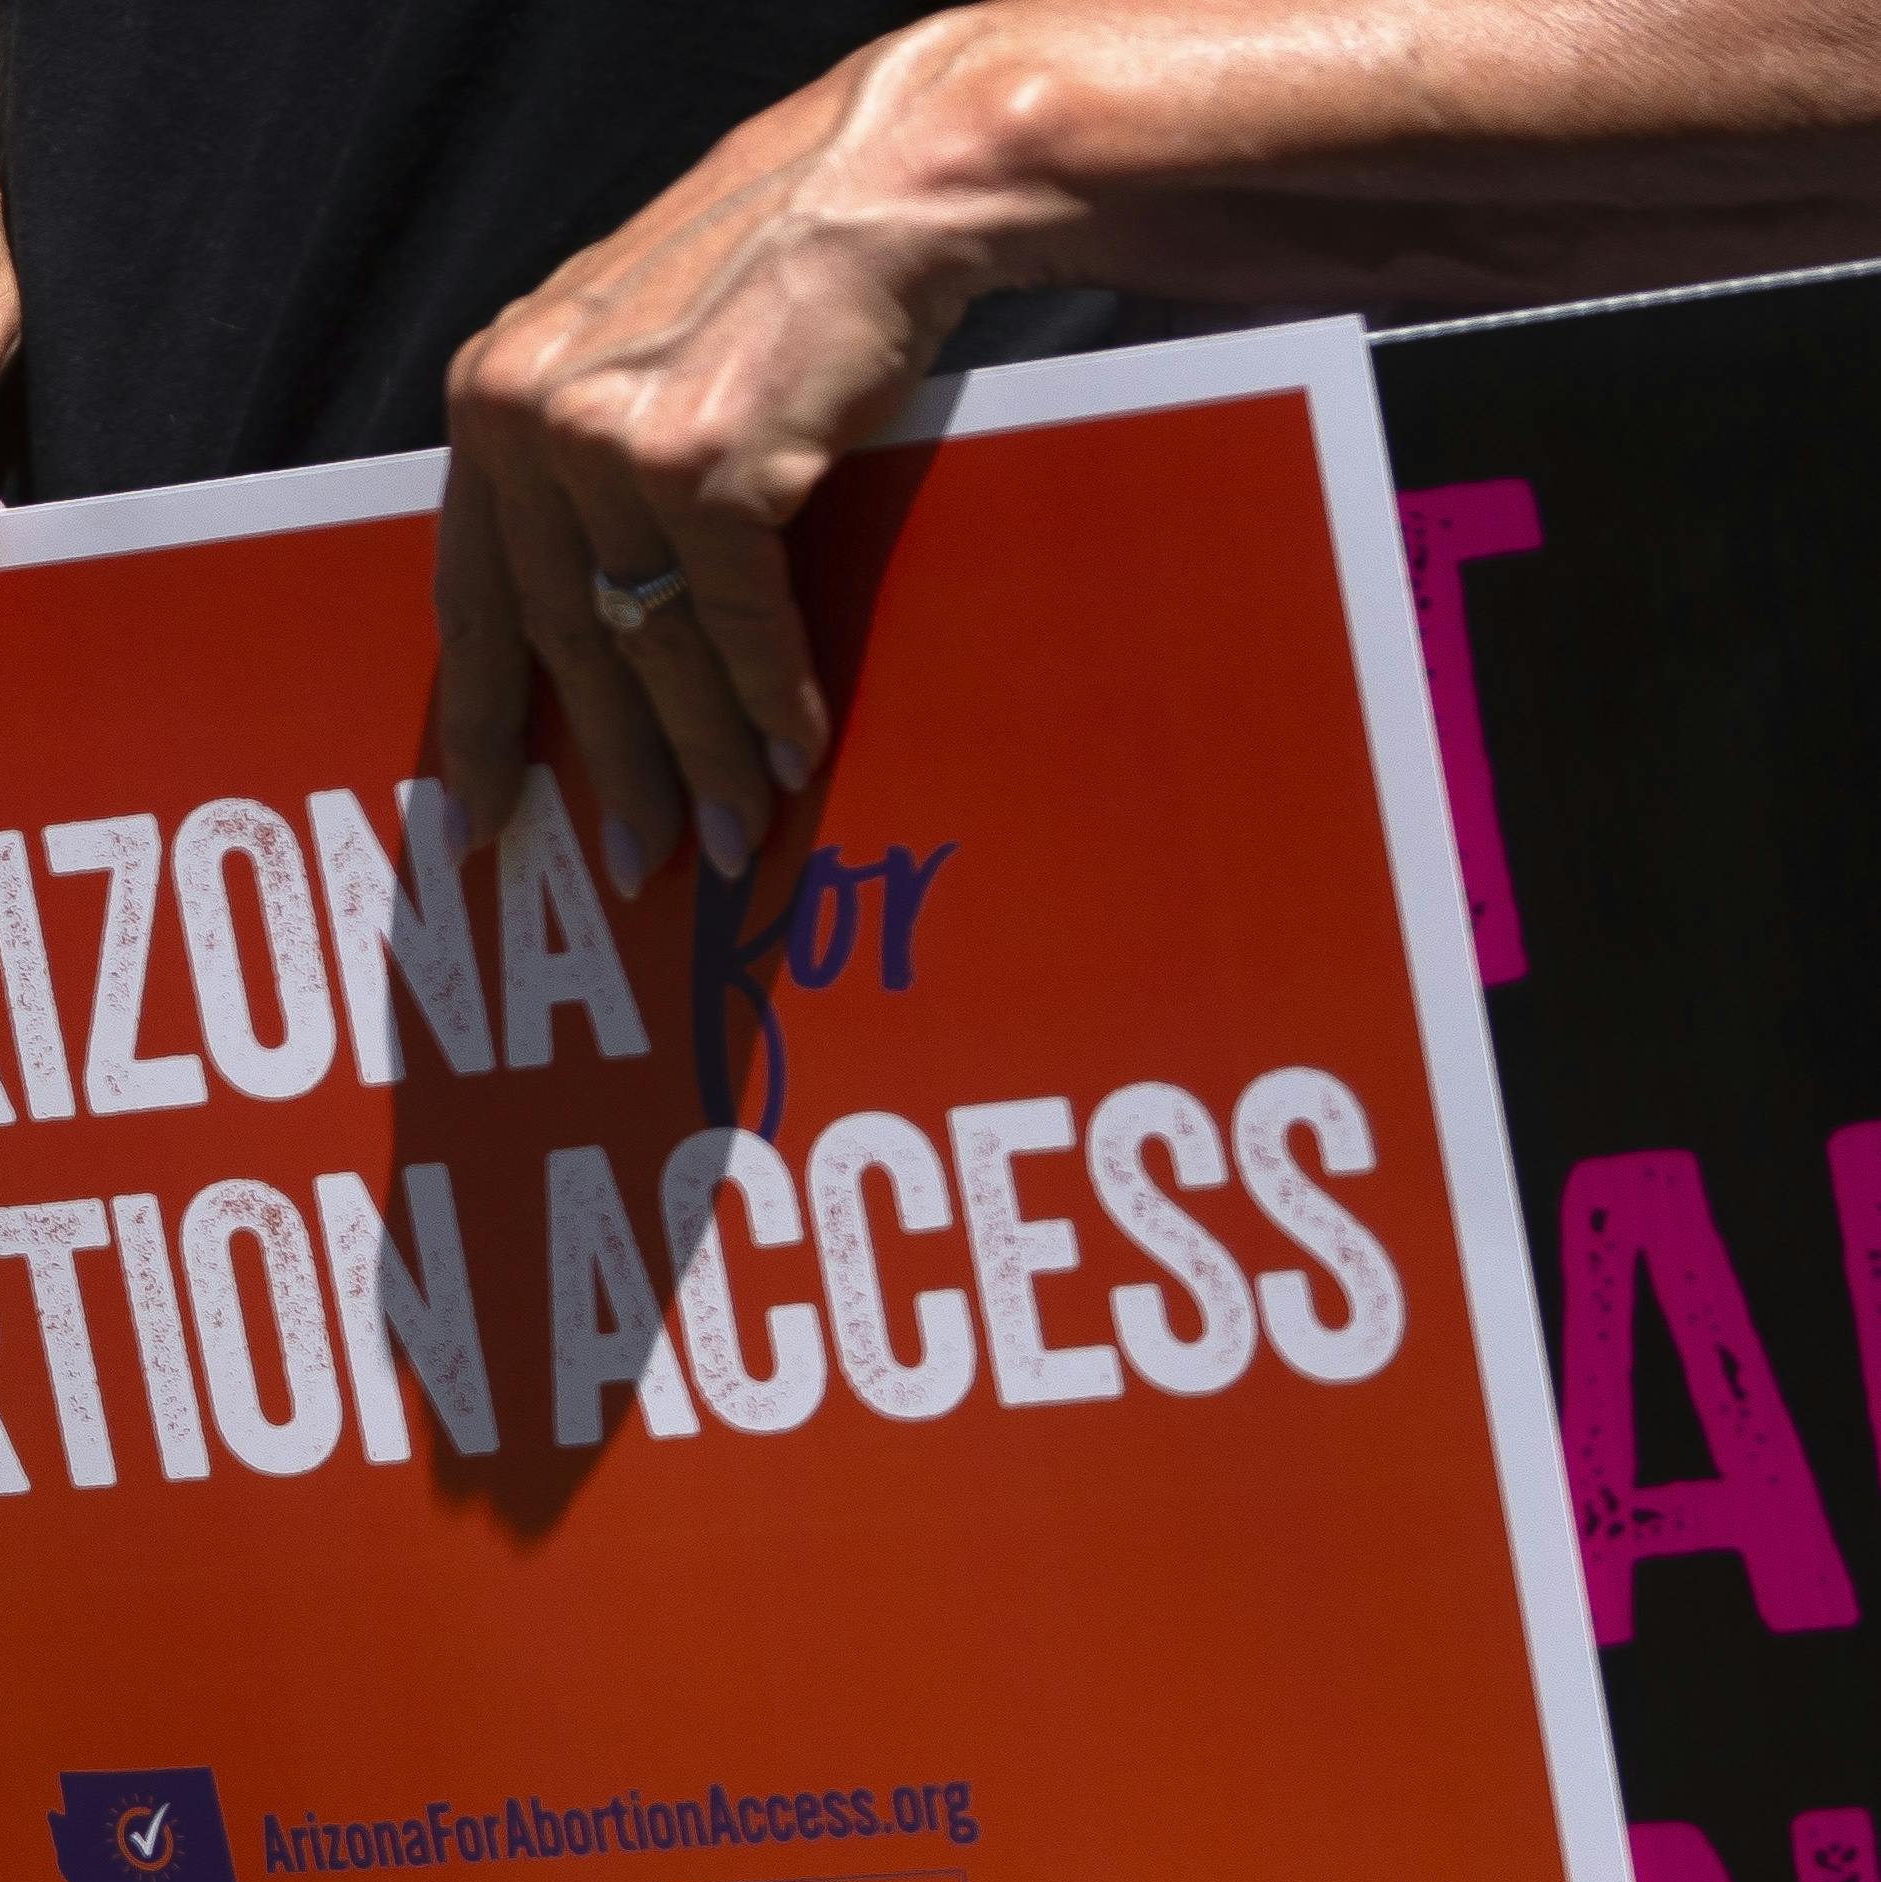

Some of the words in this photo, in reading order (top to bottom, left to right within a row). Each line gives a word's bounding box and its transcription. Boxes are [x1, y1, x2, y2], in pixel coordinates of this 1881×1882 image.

[690, 840, 960, 1141] for
[547, 1068, 1404, 1446] ACCESS
[264, 1783, 978, 1873] ArizonaForAbortionAccess.org
